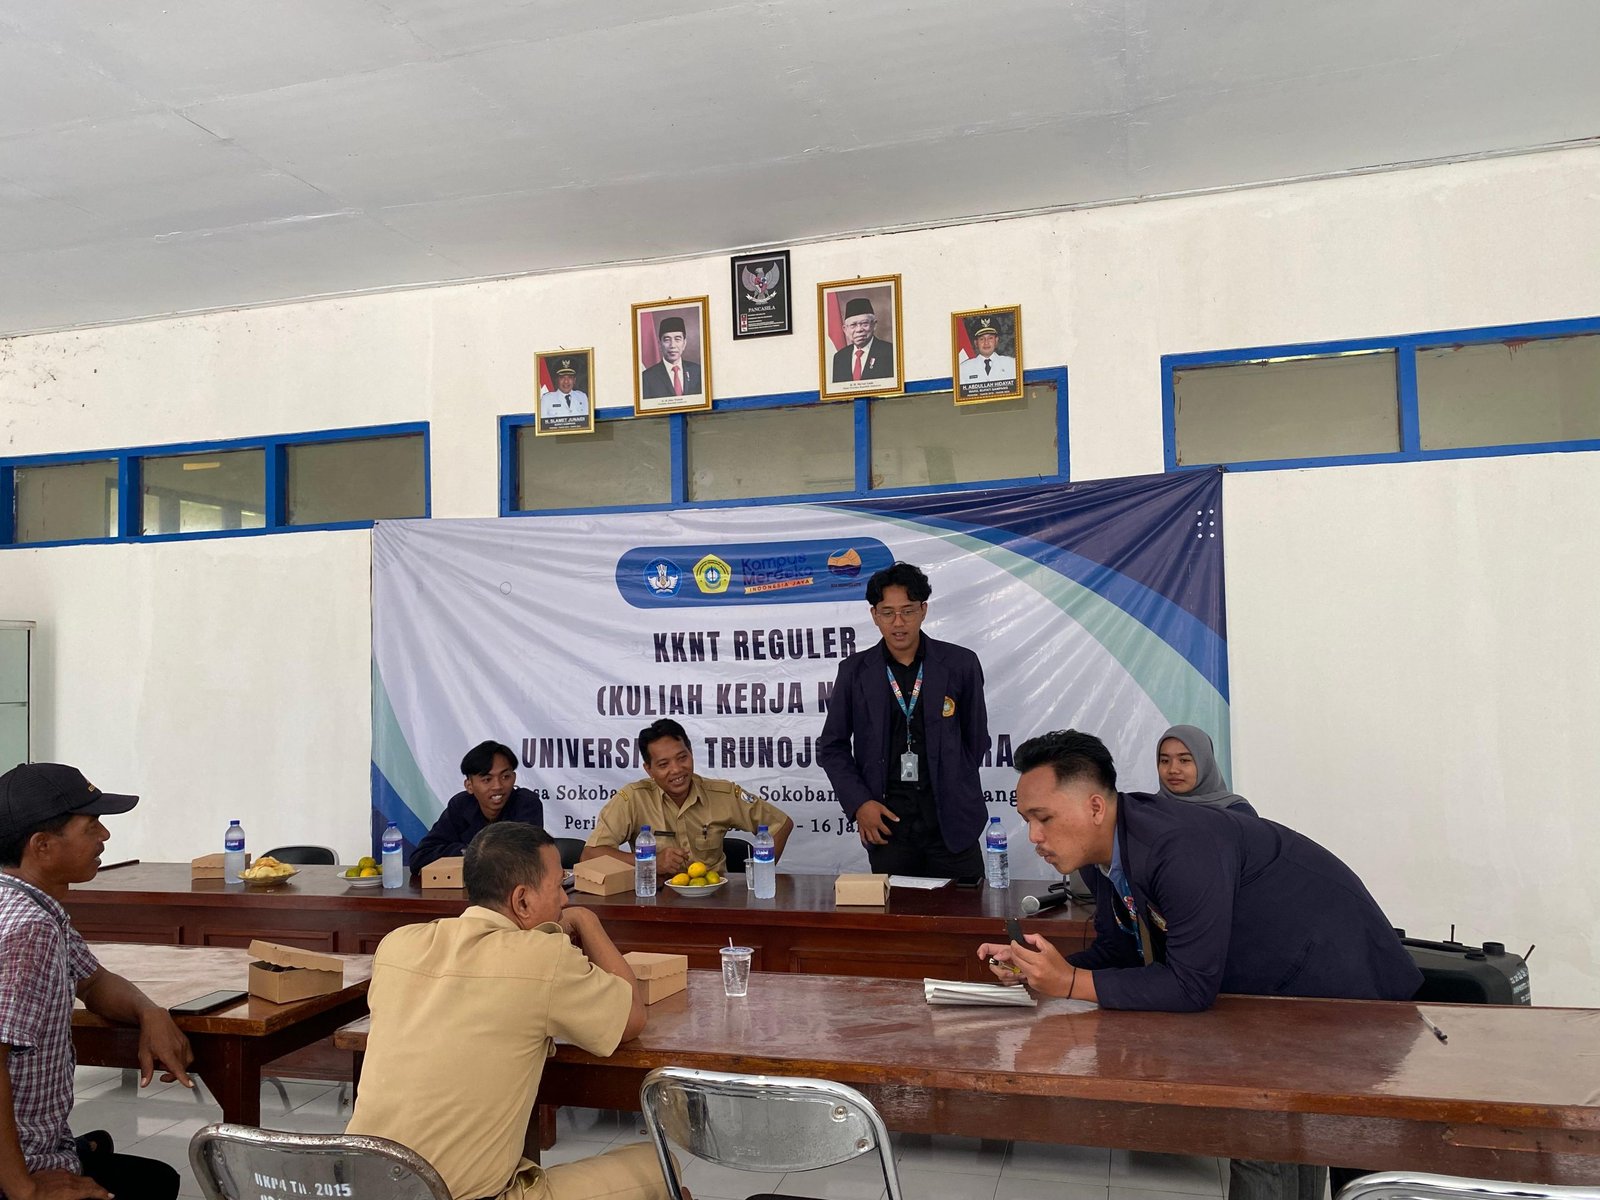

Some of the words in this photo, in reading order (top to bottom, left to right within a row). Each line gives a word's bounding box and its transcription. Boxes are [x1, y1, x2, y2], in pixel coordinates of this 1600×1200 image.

[741, 554, 807, 573] Kampus
[743, 566, 814, 587] Merdeka
[749, 583, 789, 593] INDONESIA
[653, 631, 720, 662] KKNT
[733, 627, 857, 660] REGULER
[597, 684, 703, 716] (KULIAH
[716, 683, 804, 715] KERJA
[811, 819, 831, 833] 16
[314, 1183, 353, 1197] 2015
